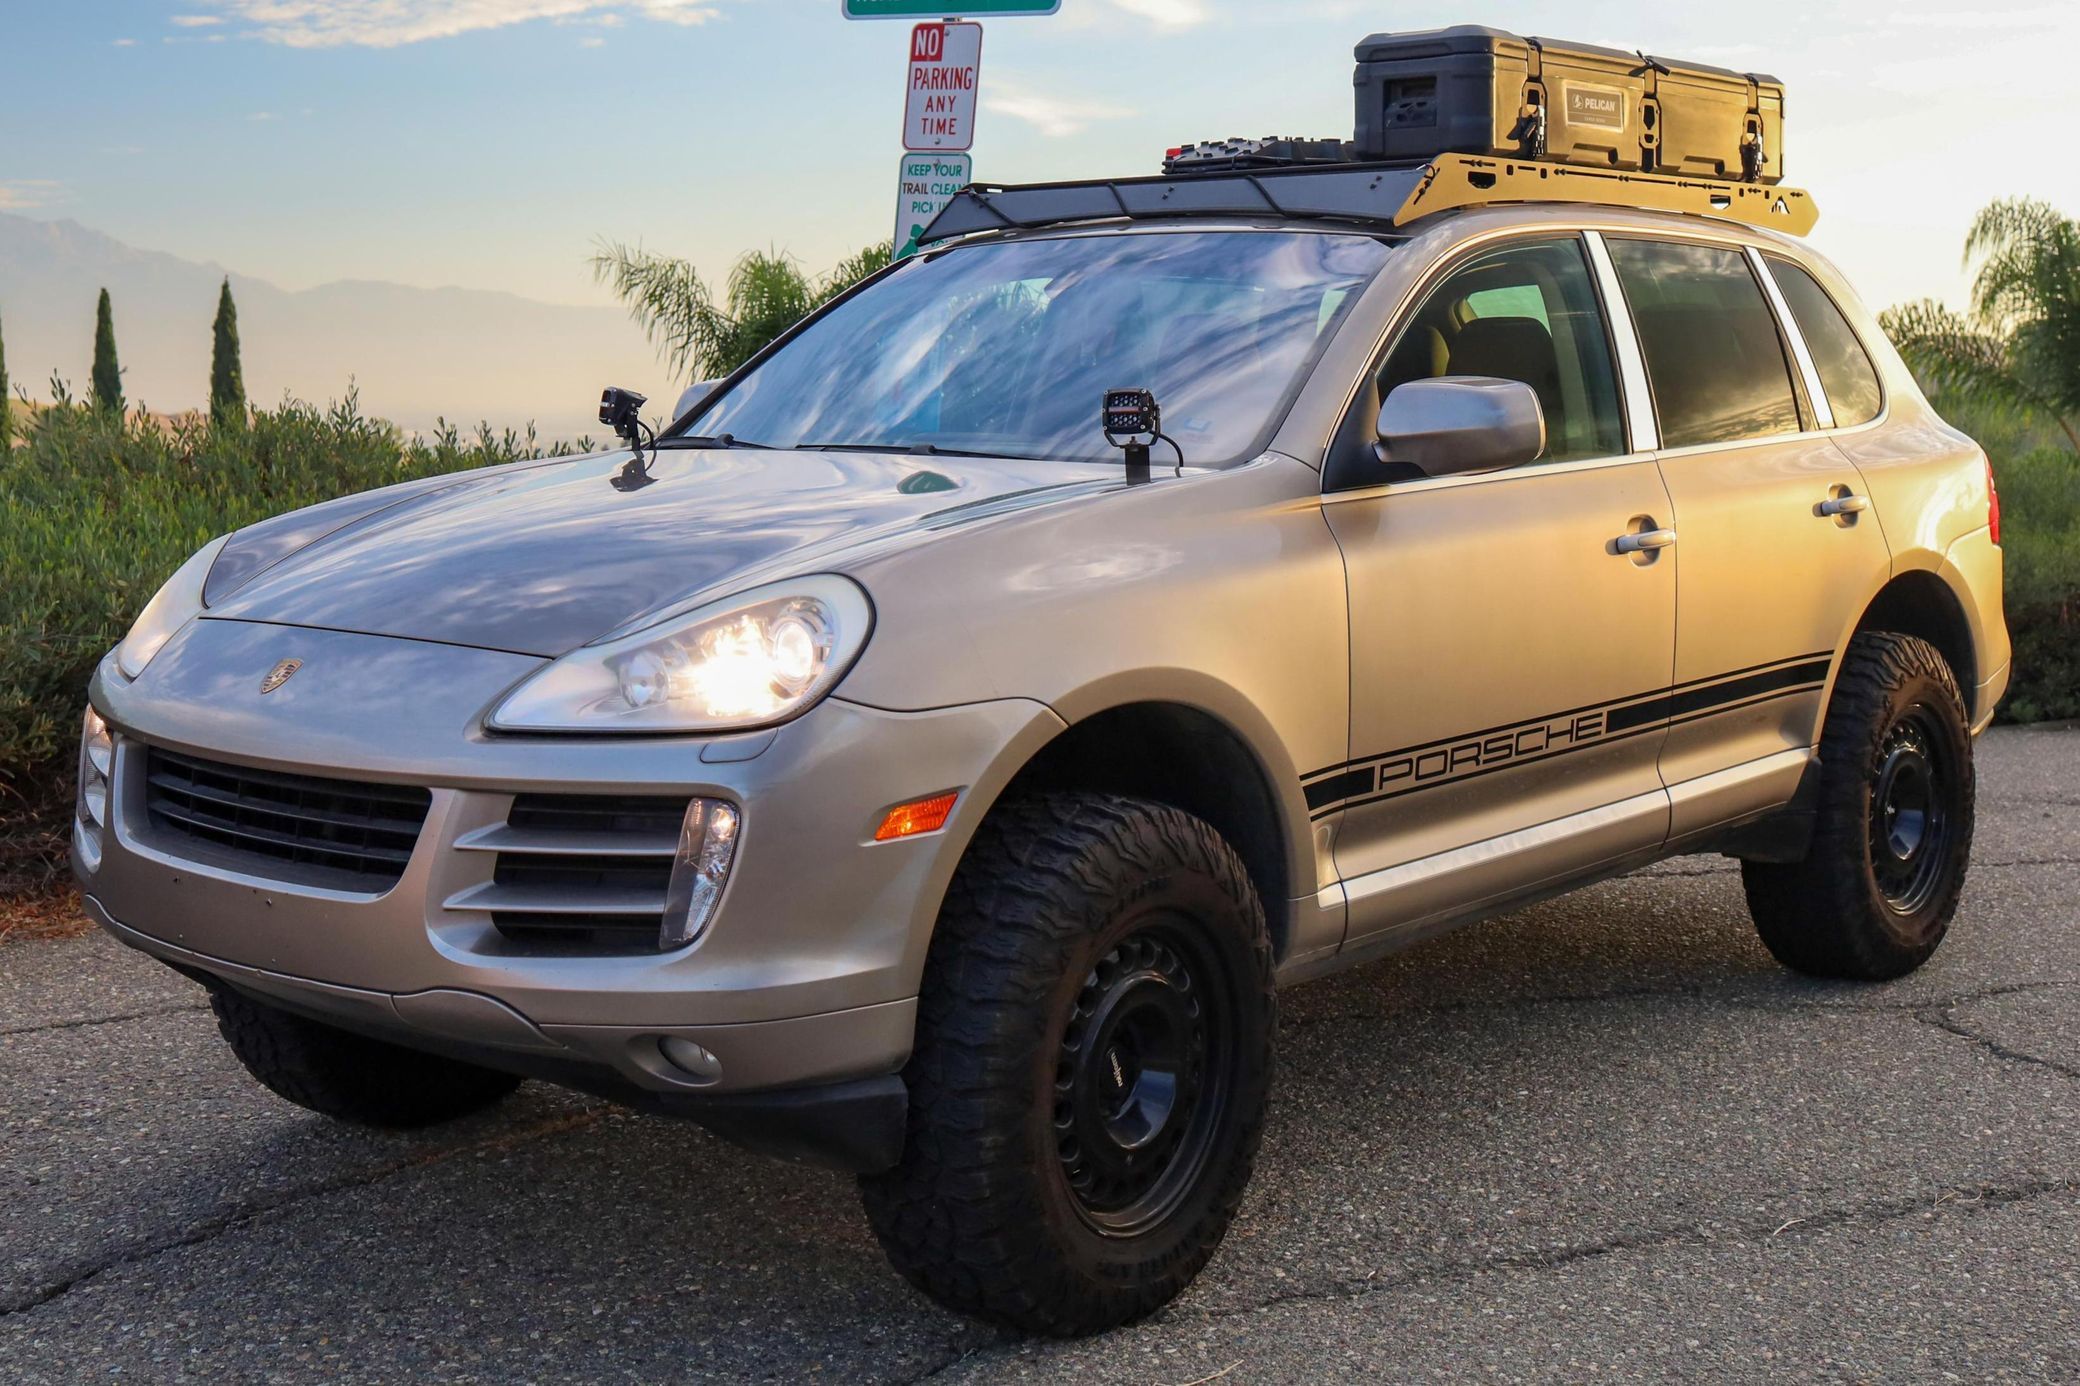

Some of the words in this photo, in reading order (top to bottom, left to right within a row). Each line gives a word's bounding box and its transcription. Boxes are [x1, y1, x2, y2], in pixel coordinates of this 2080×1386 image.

[915, 29, 940, 56] NO
[913, 67, 973, 90] PARKING
[925, 95, 957, 113] ANY
[1585, 98, 1616, 112] PELICAN
[922, 118, 957, 135] TIME
[907, 164, 931, 176] KEEP
[934, 164, 962, 177] YOUR
[902, 183, 929, 195] TRAIL
[1379, 712, 1603, 790] PORSCHE
